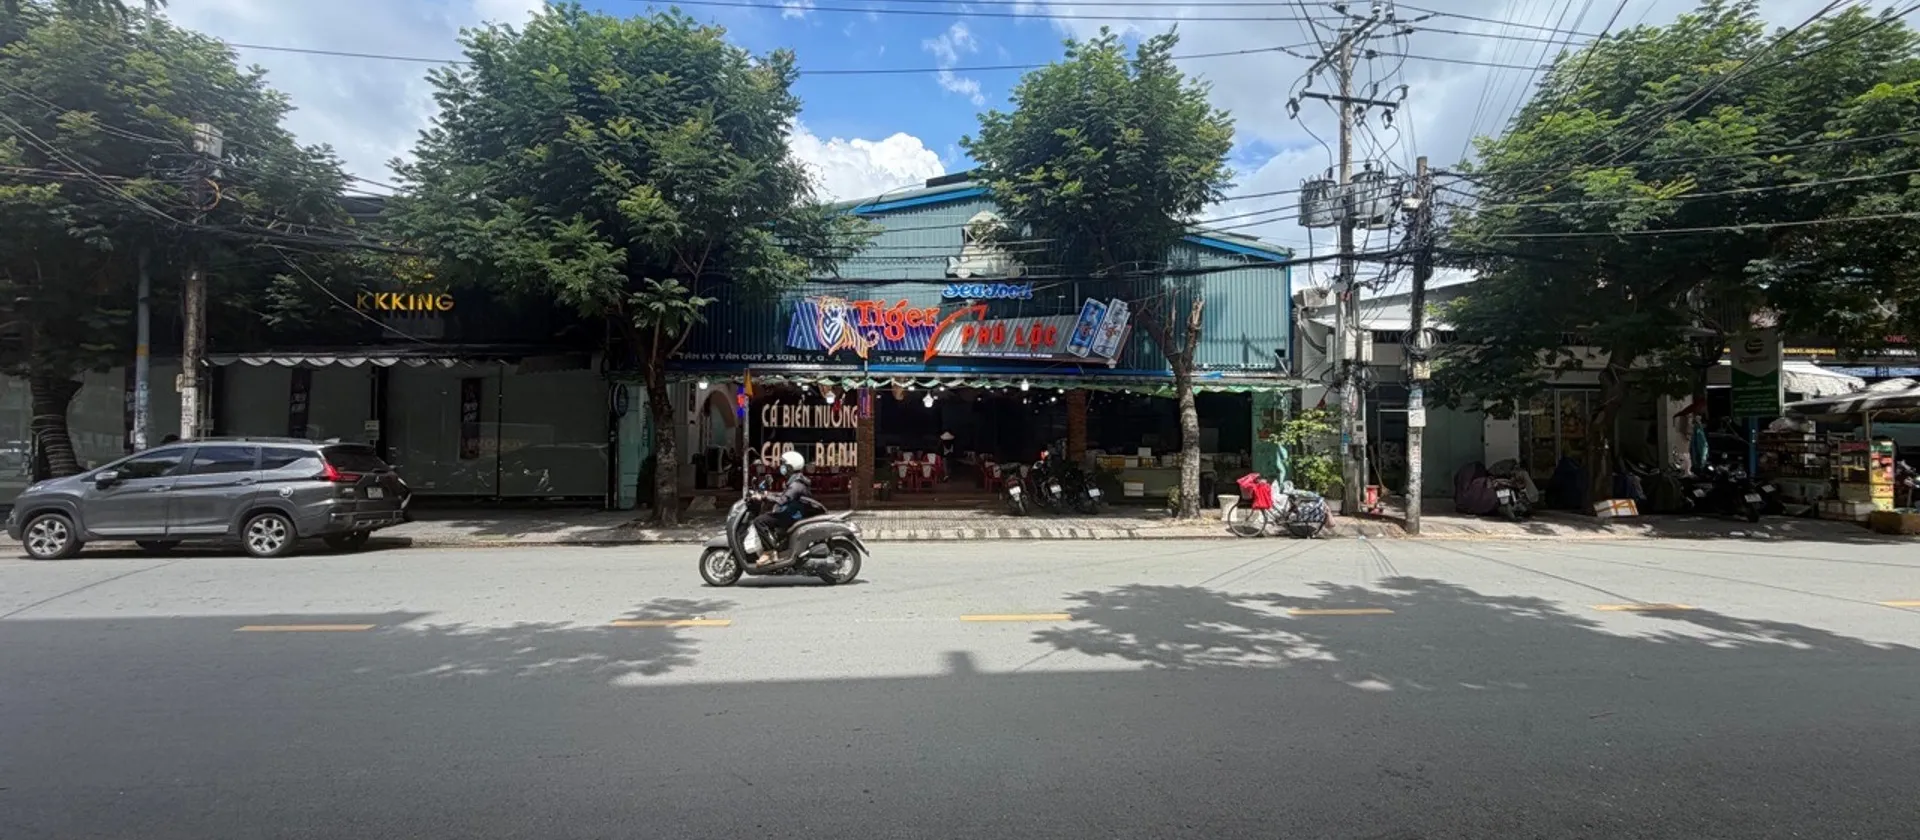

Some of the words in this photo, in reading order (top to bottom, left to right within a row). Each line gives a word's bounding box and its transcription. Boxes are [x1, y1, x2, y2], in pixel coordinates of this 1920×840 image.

[853, 299, 939, 341] Tiger
[762, 399, 780, 427] CÁ
[815, 442, 858, 467] RANH
